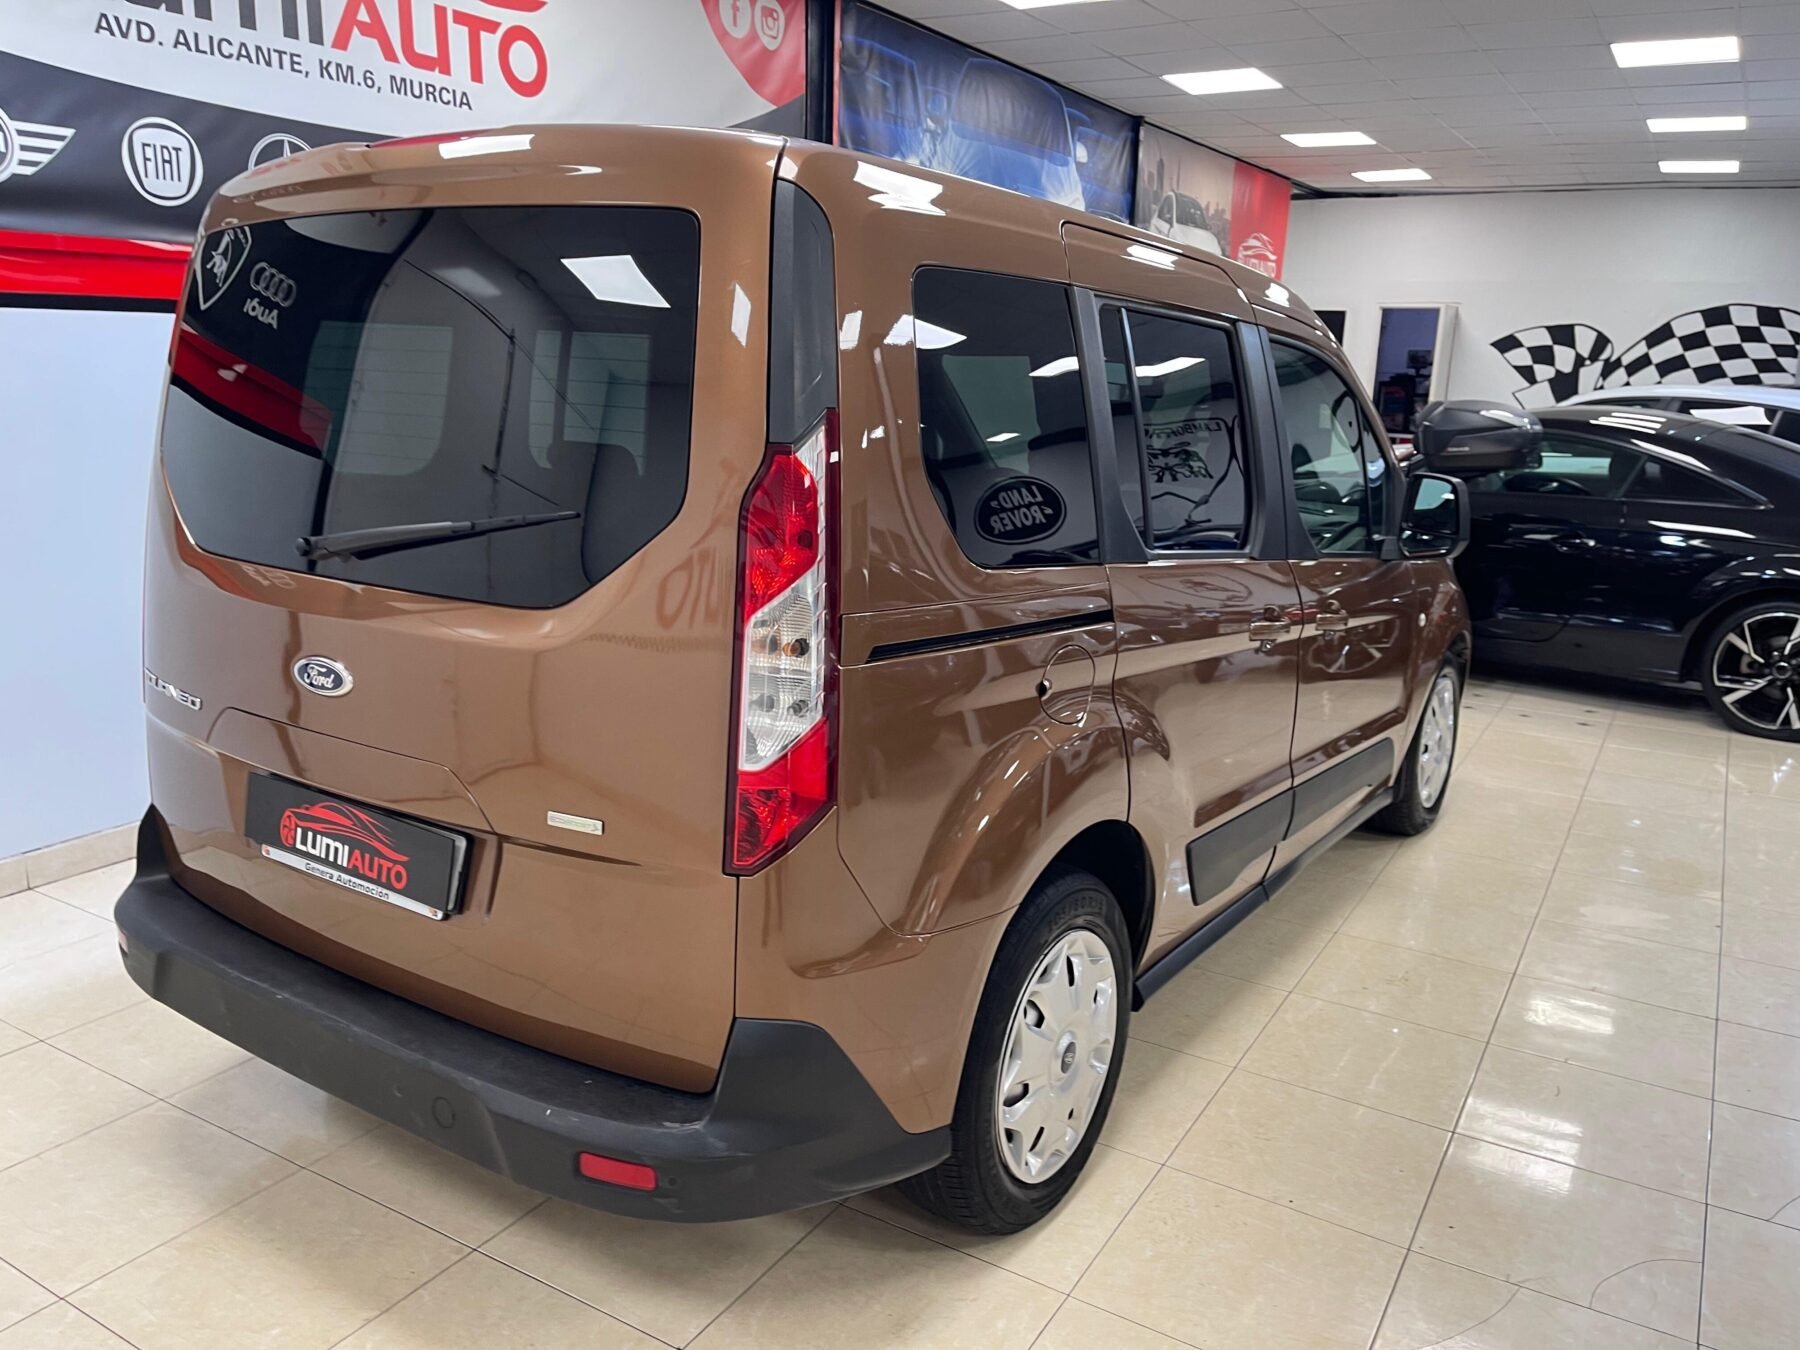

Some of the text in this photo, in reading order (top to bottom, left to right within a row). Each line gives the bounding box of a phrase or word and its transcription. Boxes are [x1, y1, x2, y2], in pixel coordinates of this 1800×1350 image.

[94, 12, 473, 111] AVD. ALICANTE, KM.6, MURCIA
[141, 141, 183, 183] FIAT
[303, 663, 335, 689] Ford
[304, 862, 334, 880] Genera
